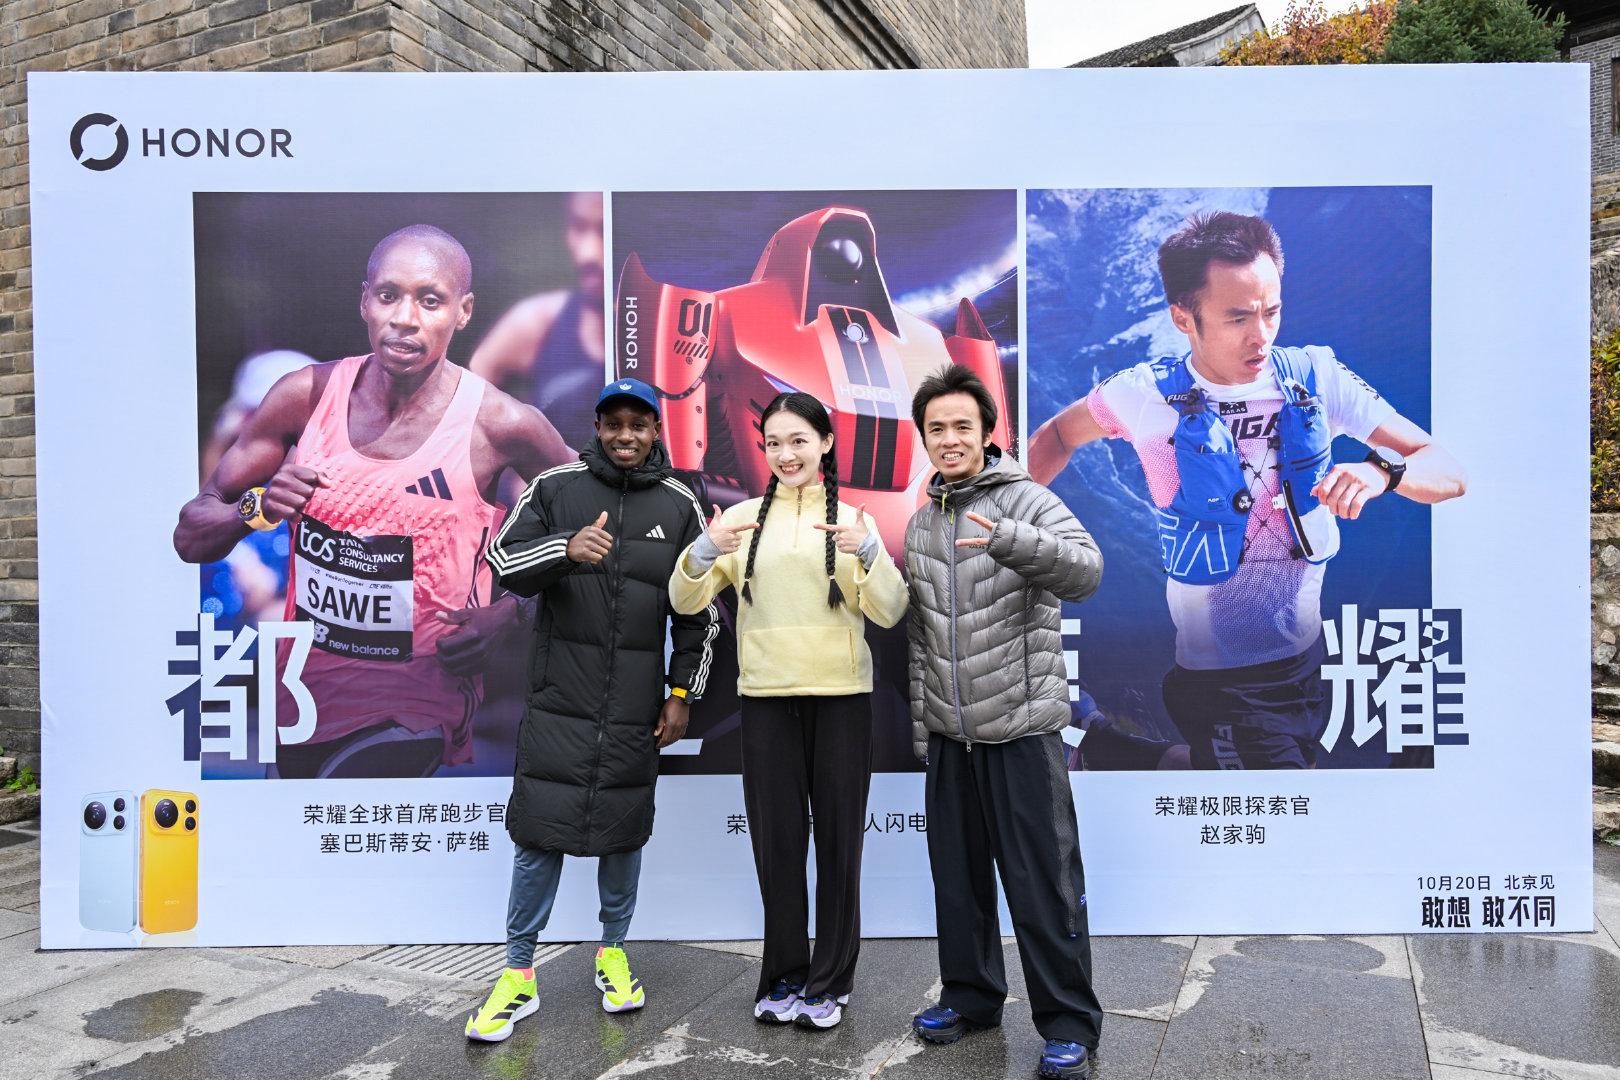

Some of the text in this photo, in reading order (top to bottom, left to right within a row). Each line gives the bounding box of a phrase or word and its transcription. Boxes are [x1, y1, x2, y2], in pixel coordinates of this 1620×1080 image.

[142, 127, 294, 158] HONOR
[678, 298, 713, 339] 01
[625, 296, 638, 369] HONOR
[839, 383, 903, 402] HONOR
[338, 556, 378, 573] SERVICES
[339, 546, 405, 564] CONSULTANCY
[307, 577, 392, 624] SAWE
[328, 639, 400, 656] new balance
[165, 612, 318, 764] 都
[1319, 603, 1470, 754] 耀
[303, 802, 506, 825] 荣耀全球首席跑步官
[1155, 795, 1310, 817] 荣耀极限探索官
[320, 831, 490, 853] 塞巴斯蒂安·萨维
[1417, 874, 1555, 891] 10月20日 北京见
[1421, 896, 1555, 928] 敢想 敢不同
